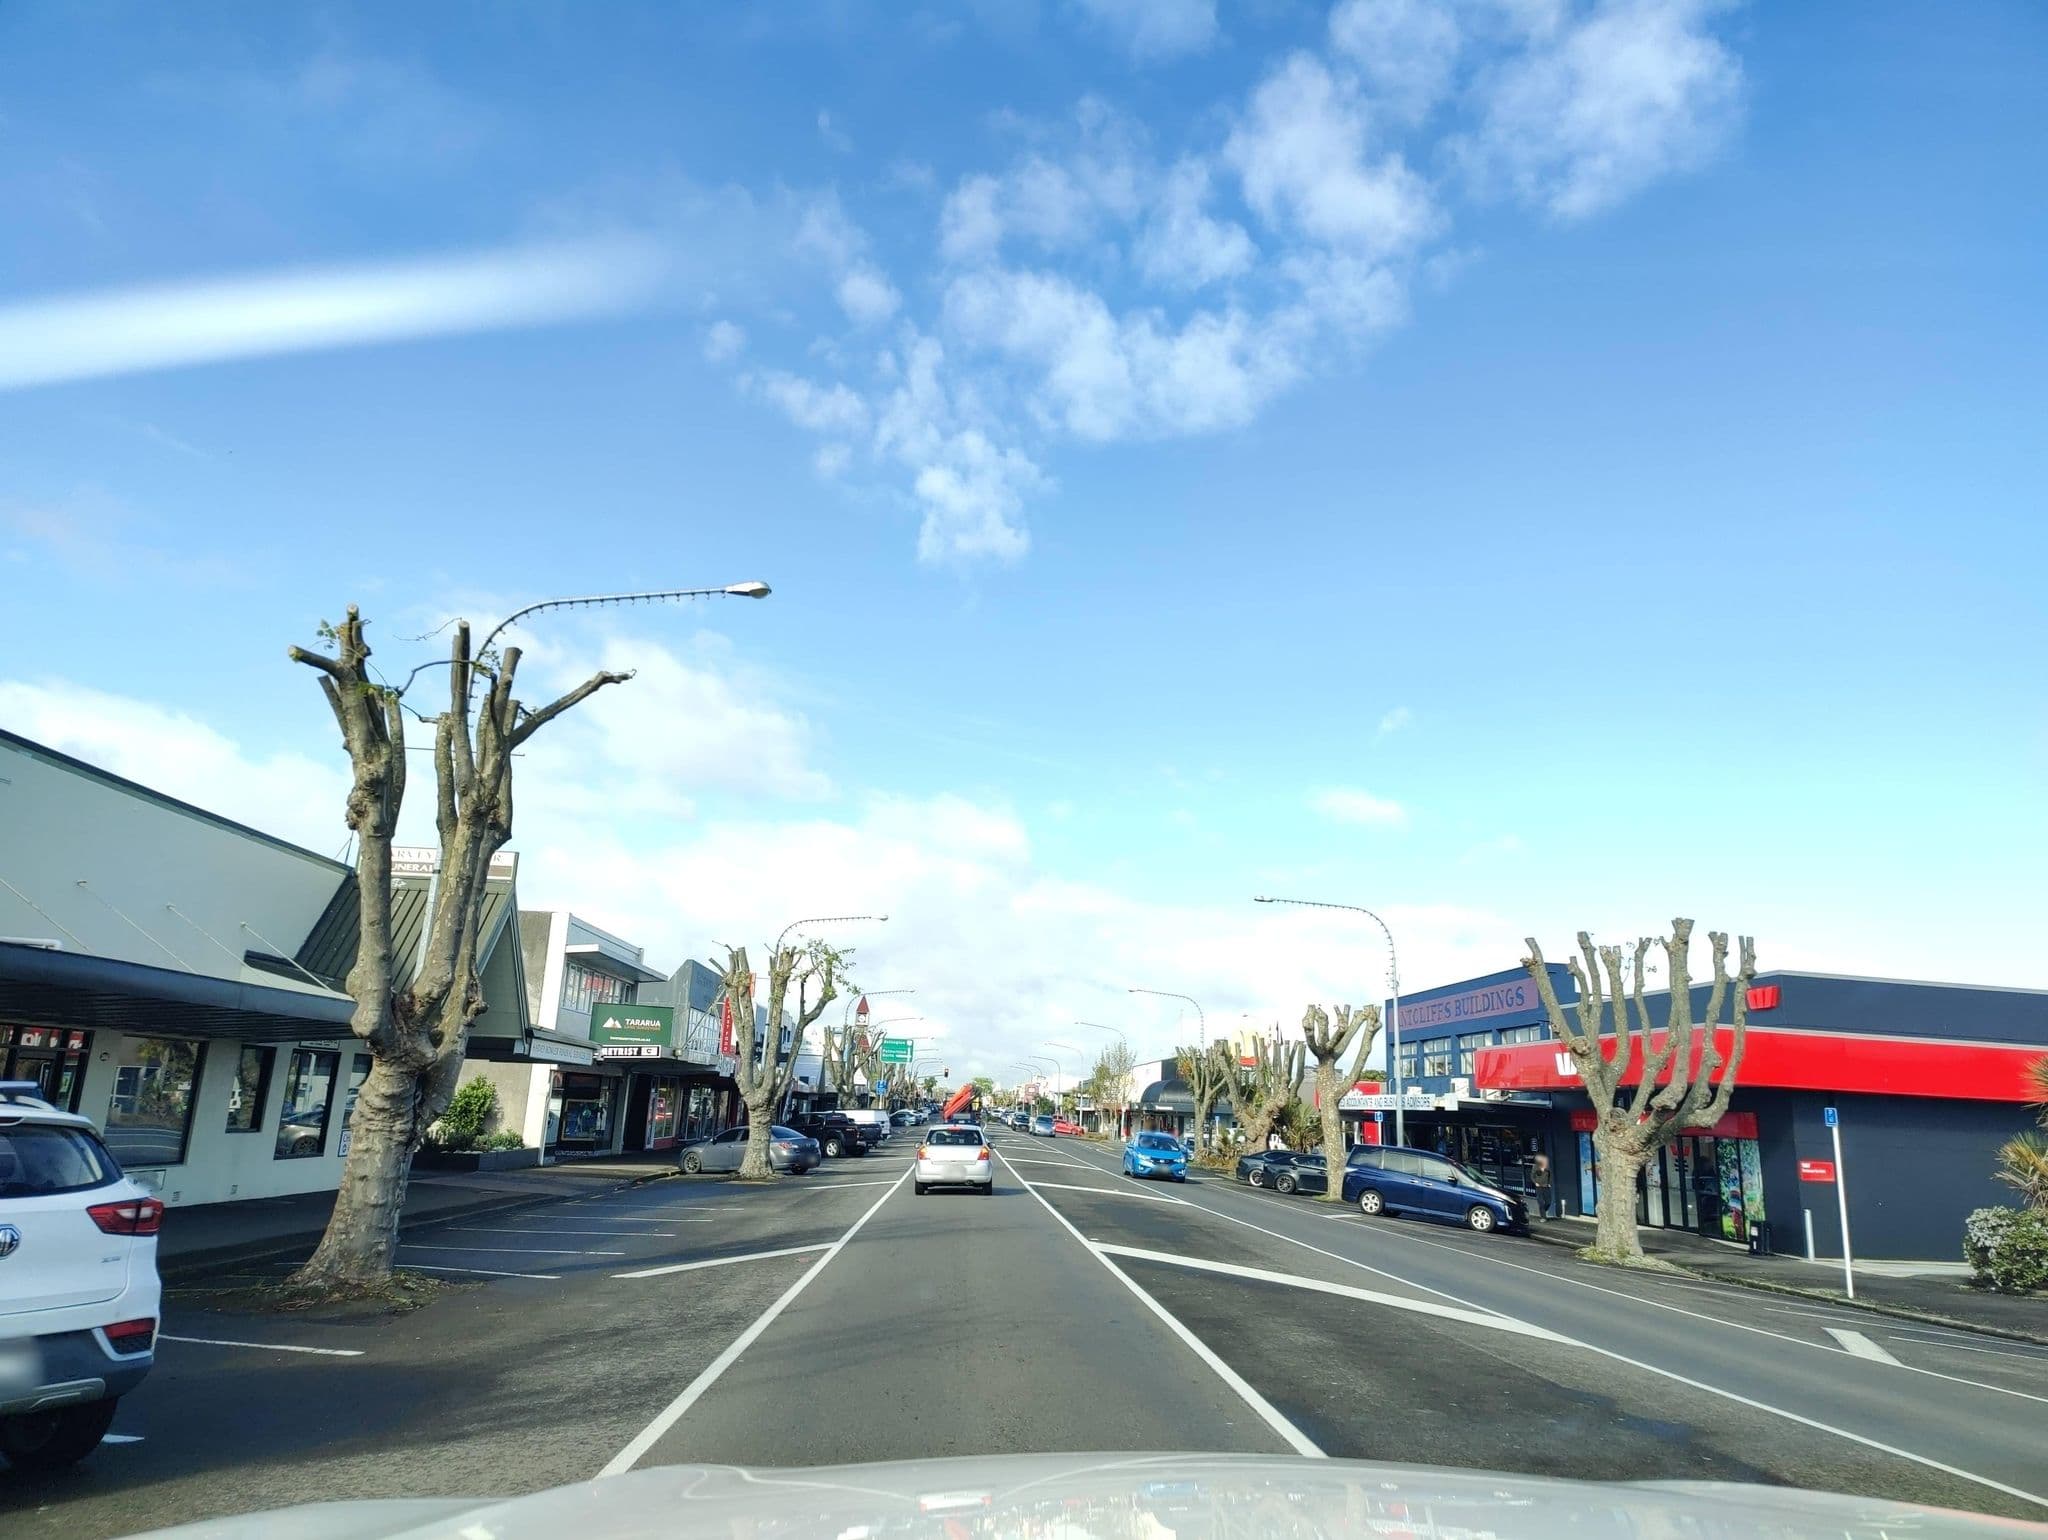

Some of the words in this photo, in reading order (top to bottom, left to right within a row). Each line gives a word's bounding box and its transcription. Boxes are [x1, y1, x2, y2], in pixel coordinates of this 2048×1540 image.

[1398, 1001, 1452, 1027] NTCLIFFS
[1454, 986, 1525, 1017] BUILDINGS
[625, 1018, 661, 1027] TARARUA
